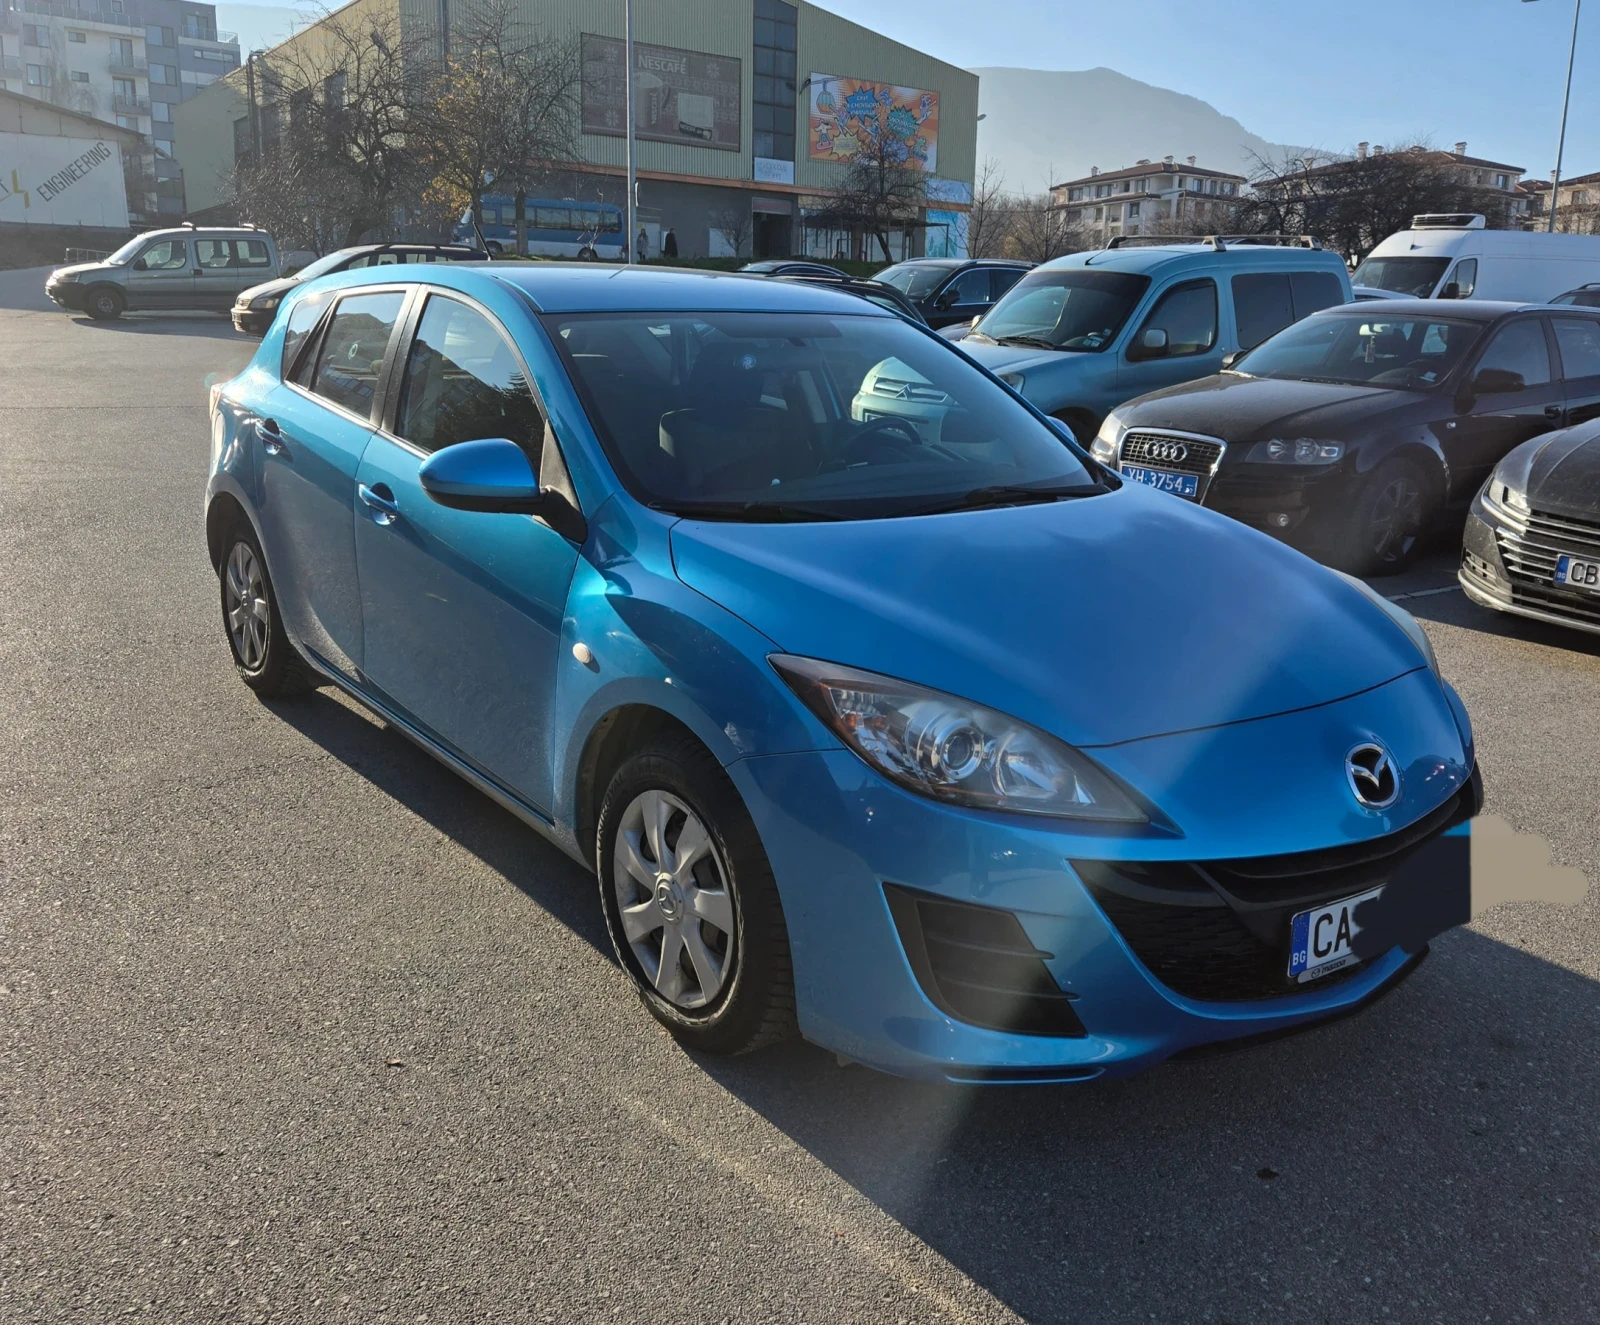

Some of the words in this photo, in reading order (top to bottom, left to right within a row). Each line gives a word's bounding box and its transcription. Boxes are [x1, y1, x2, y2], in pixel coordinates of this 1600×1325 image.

[638, 54, 687, 75] NESCAFÉ
[36, 141, 112, 202] ENGINEERING
[1571, 562, 1598, 585] CB
[1292, 949, 1307, 967] BG
[1313, 906, 1352, 958] CA
